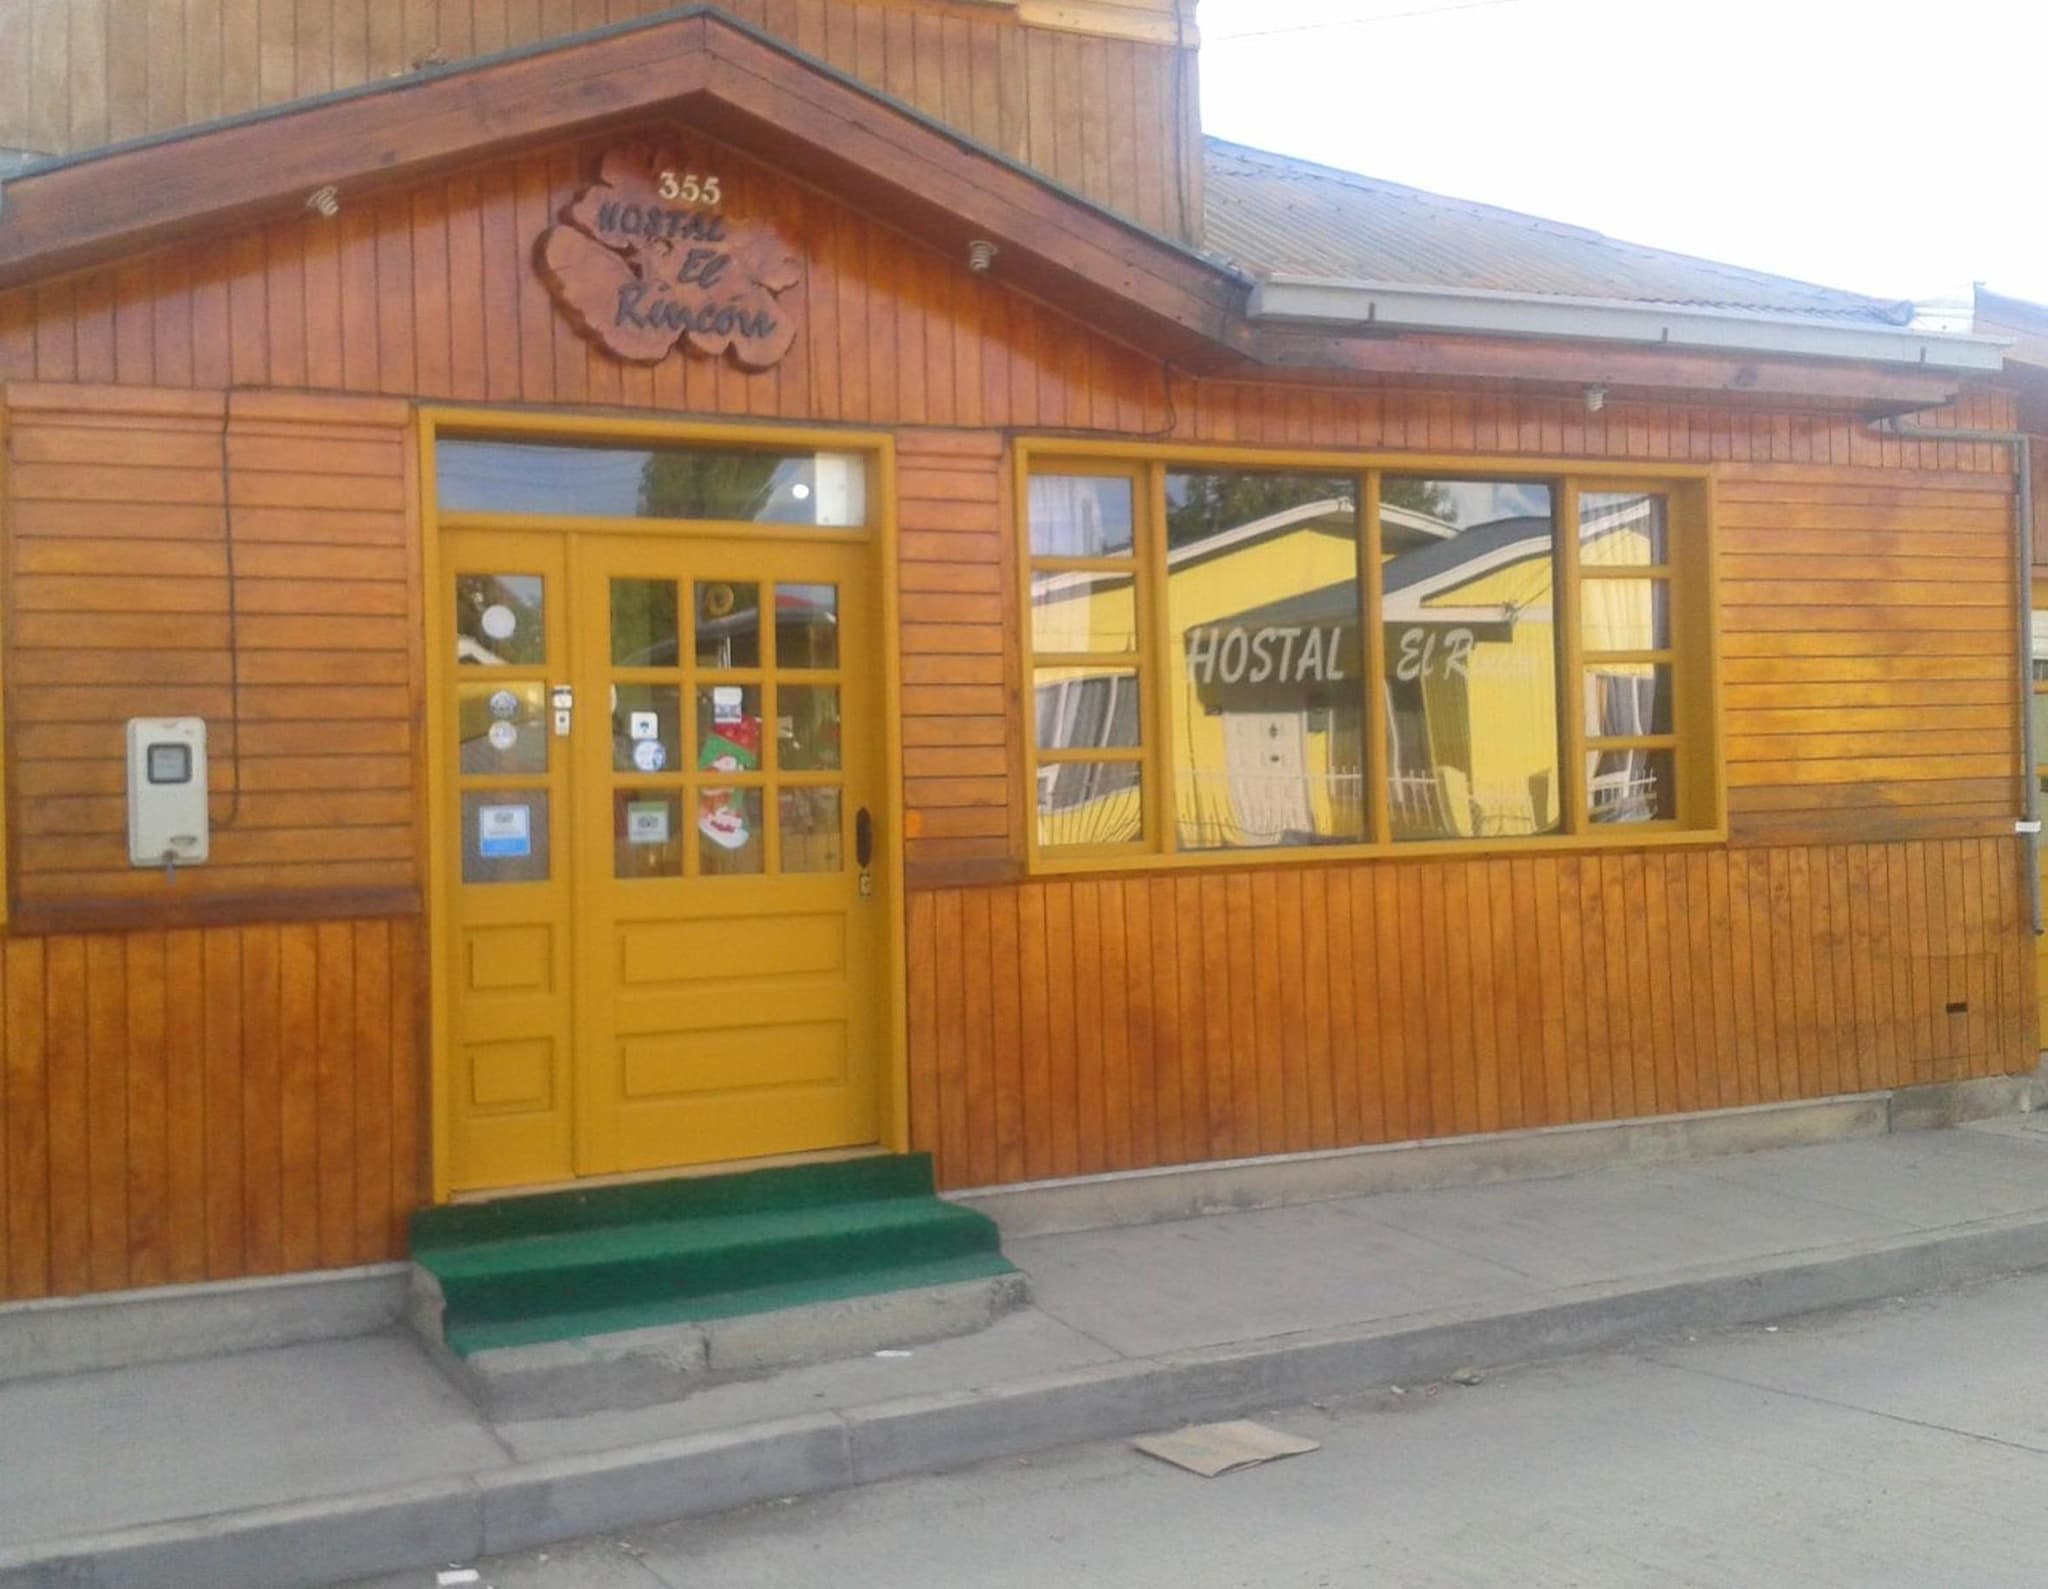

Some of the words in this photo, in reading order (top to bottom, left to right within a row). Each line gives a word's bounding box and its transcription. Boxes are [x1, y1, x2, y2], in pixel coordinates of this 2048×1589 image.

[658, 170, 721, 204] 355
[596, 200, 727, 242] HOSTAL
[677, 248, 731, 289] El
[614, 280, 777, 338] Rincón
[1186, 626, 1345, 684] HOSTAL
[1396, 628, 1437, 681] El
